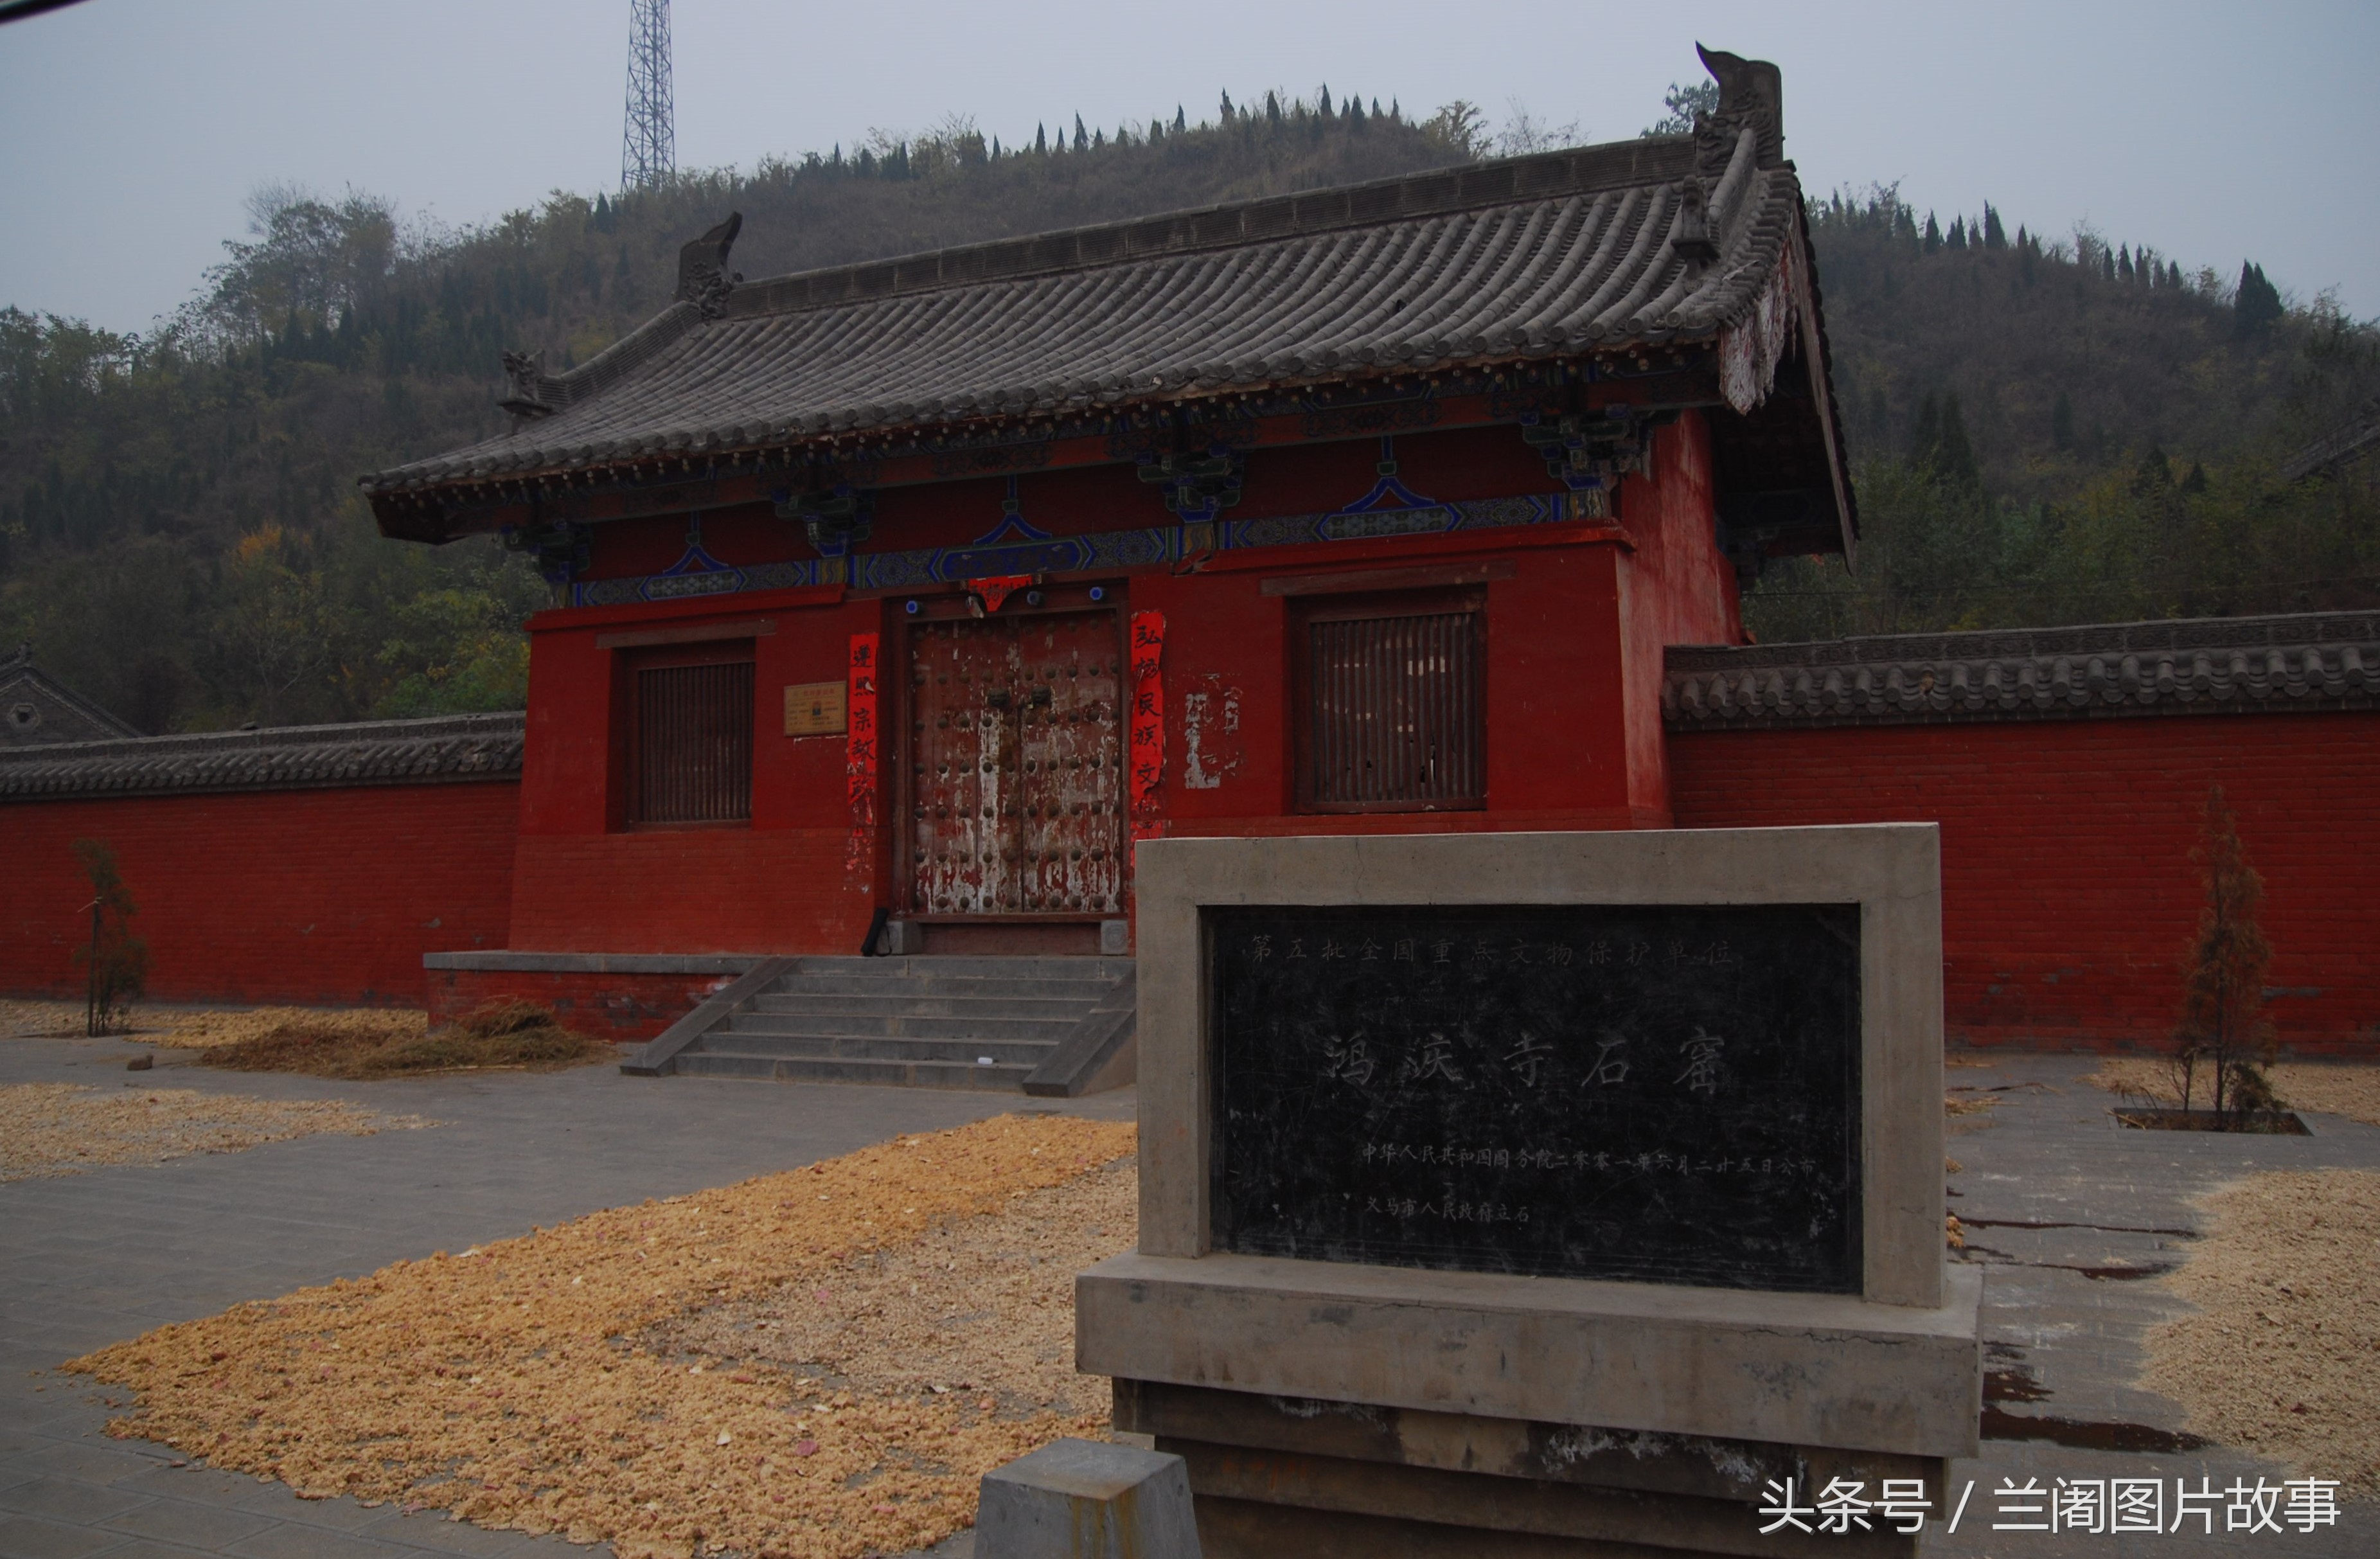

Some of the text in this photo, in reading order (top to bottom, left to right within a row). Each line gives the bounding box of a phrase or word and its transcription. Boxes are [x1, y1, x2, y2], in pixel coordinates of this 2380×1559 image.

[1133, 625, 1162, 812] 弘扬民族文
[1252, 934, 1733, 966] 第五批全国重点文物保护单位
[1324, 1026, 1725, 1094] 鸿庆寺石窟
[1365, 1197, 1529, 1223] 义马市人民政府立石
